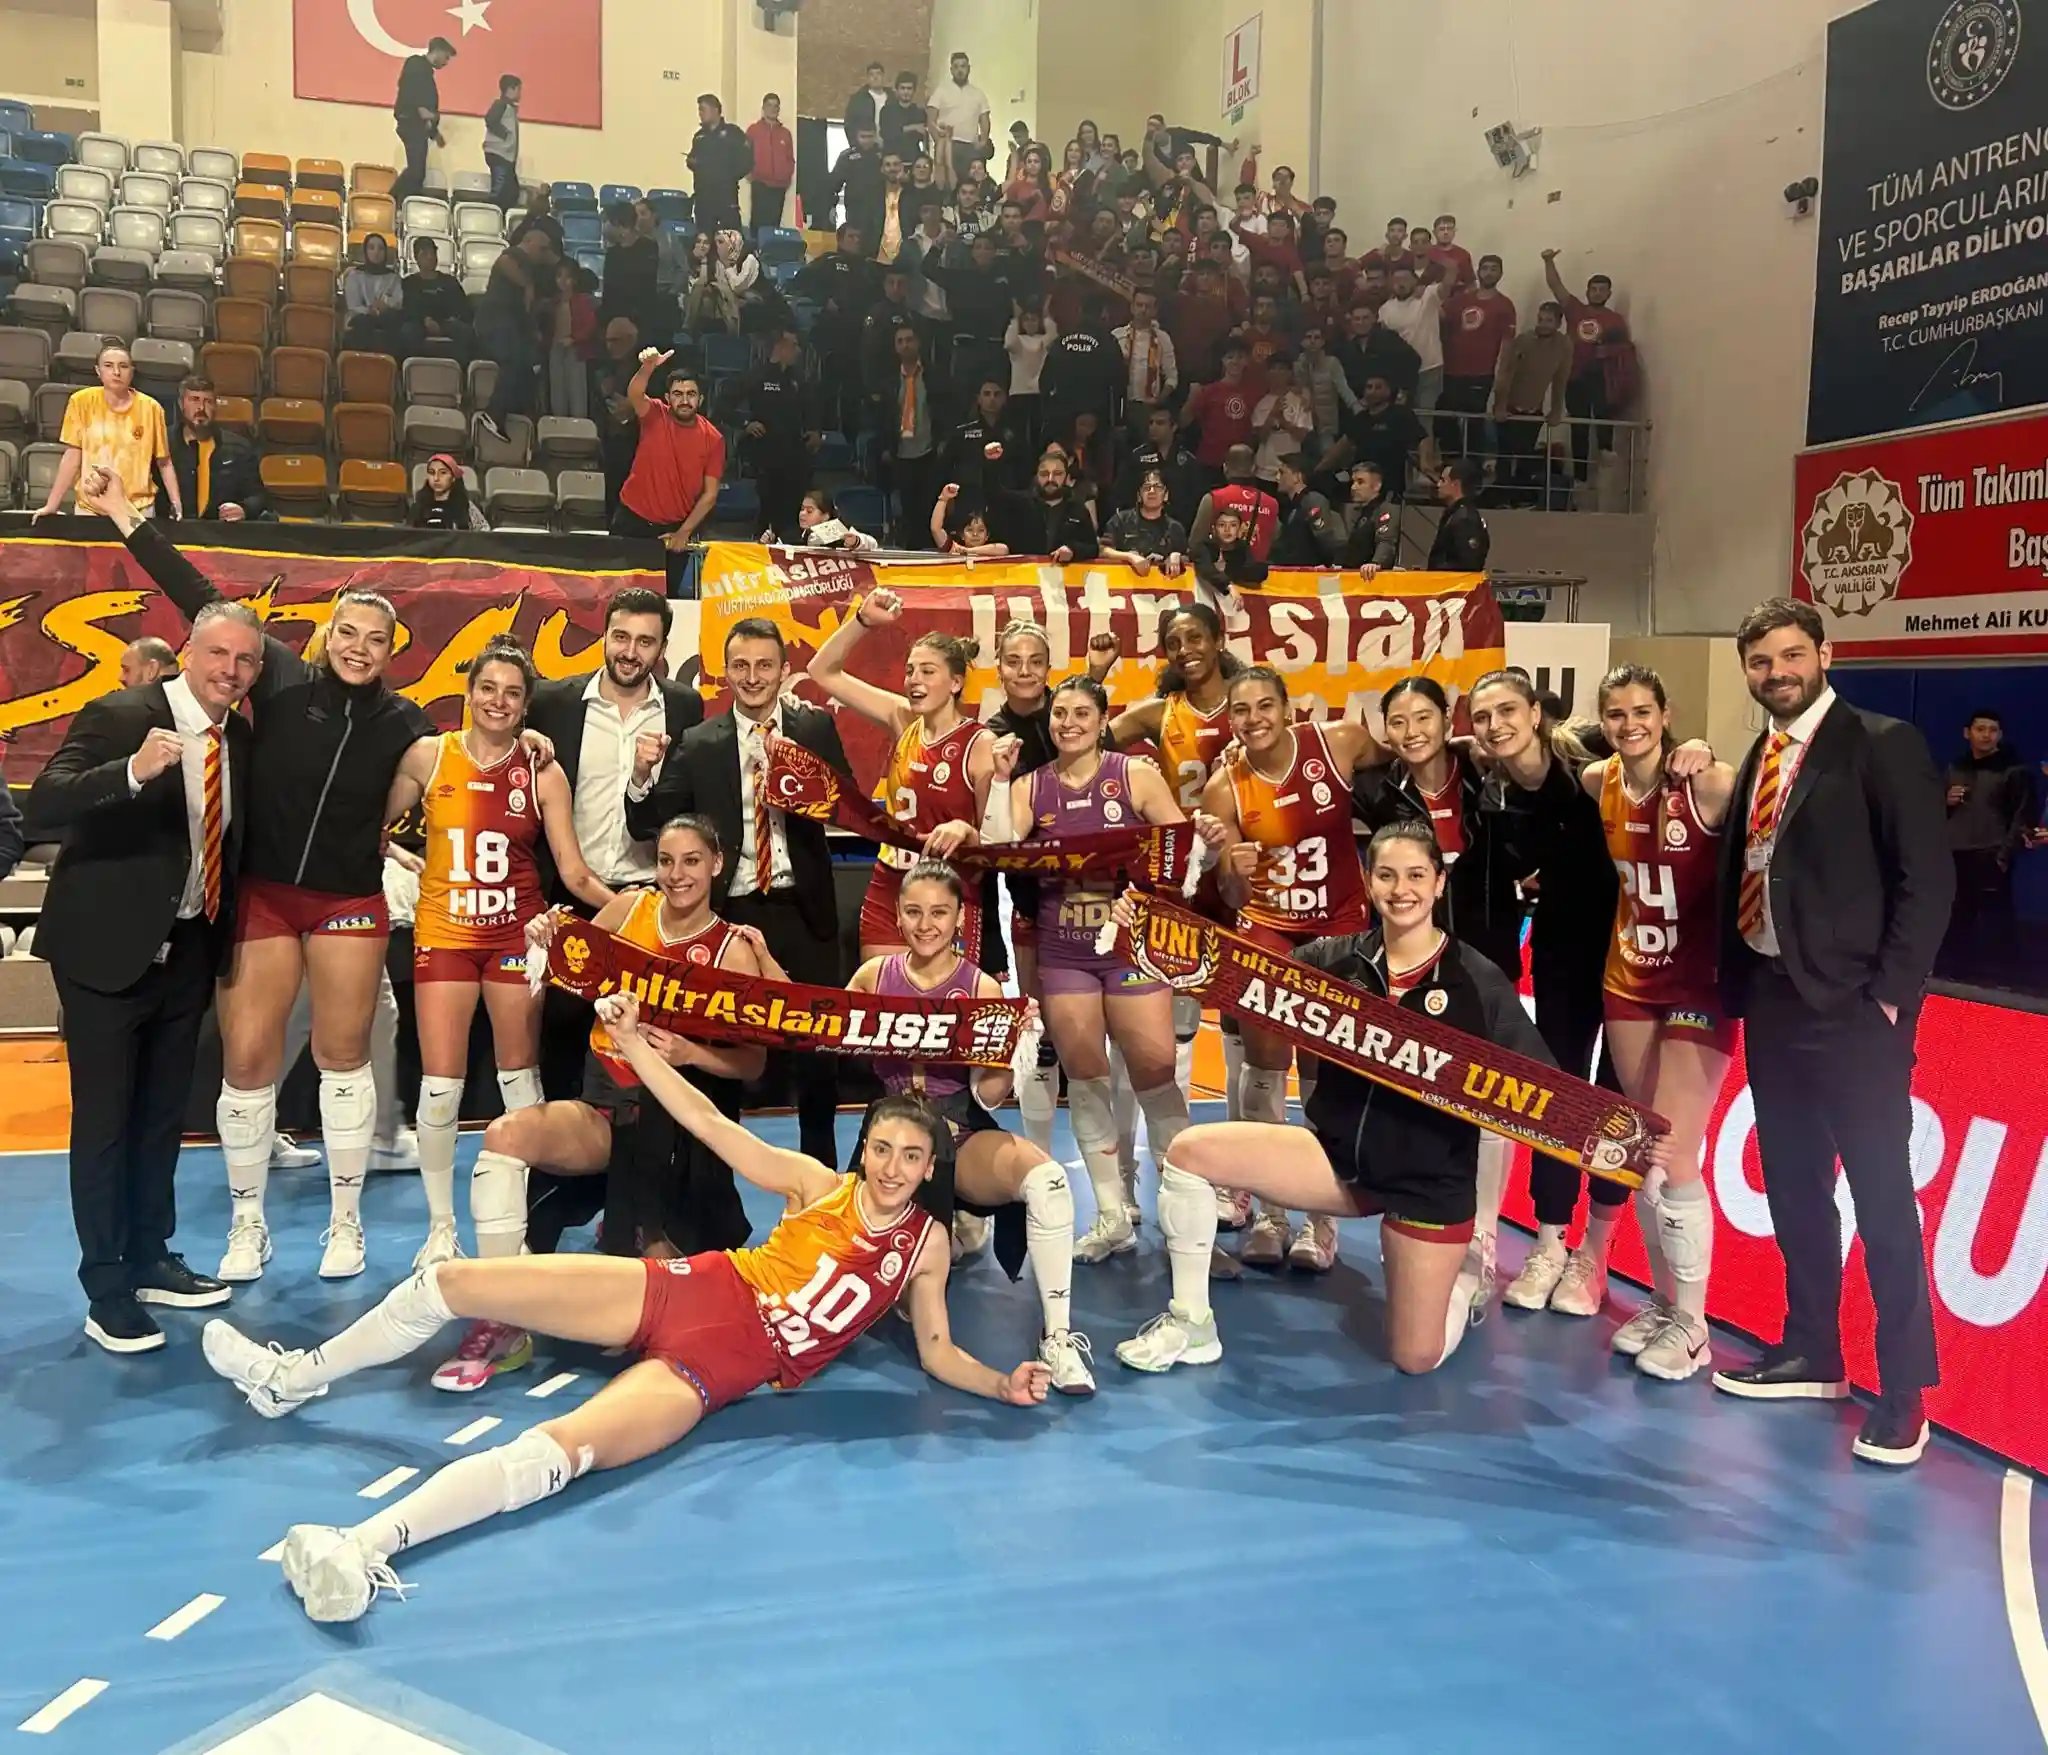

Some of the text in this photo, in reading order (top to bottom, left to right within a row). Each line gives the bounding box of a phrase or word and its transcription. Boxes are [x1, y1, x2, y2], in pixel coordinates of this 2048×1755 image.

[1232, 33, 1247, 85] L
[1227, 79, 1251, 107] BLOK
[1867, 126, 2048, 211] TÜM ANTREN
[1838, 230, 1866, 262] VE
[1840, 239, 1959, 294] BAŞARILAR
[1878, 271, 2048, 331] Recep Tayyip ERDOĞAN
[1882, 334, 1905, 353] T.C.
[1918, 473, 1965, 513] Tüm
[702, 558, 858, 598] ultrAslan
[1824, 563, 1889, 581] T.C. AKSARAY
[1835, 577, 1876, 594] VALİLİĞİ
[1905, 612, 1979, 632] Mehmet
[1985, 609, 2011, 628] Ali
[448, 828, 510, 883] 18
[1267, 836, 1328, 886] 33
[328, 916, 371, 930] aksa
[1151, 915, 1201, 960] UNI
[1232, 950, 1361, 1010] ultrAslan
[1669, 1011, 1708, 1028] aksa
[1238, 977, 1554, 1121] AKSARAY UNI
[786, 1252, 871, 1333] 10
